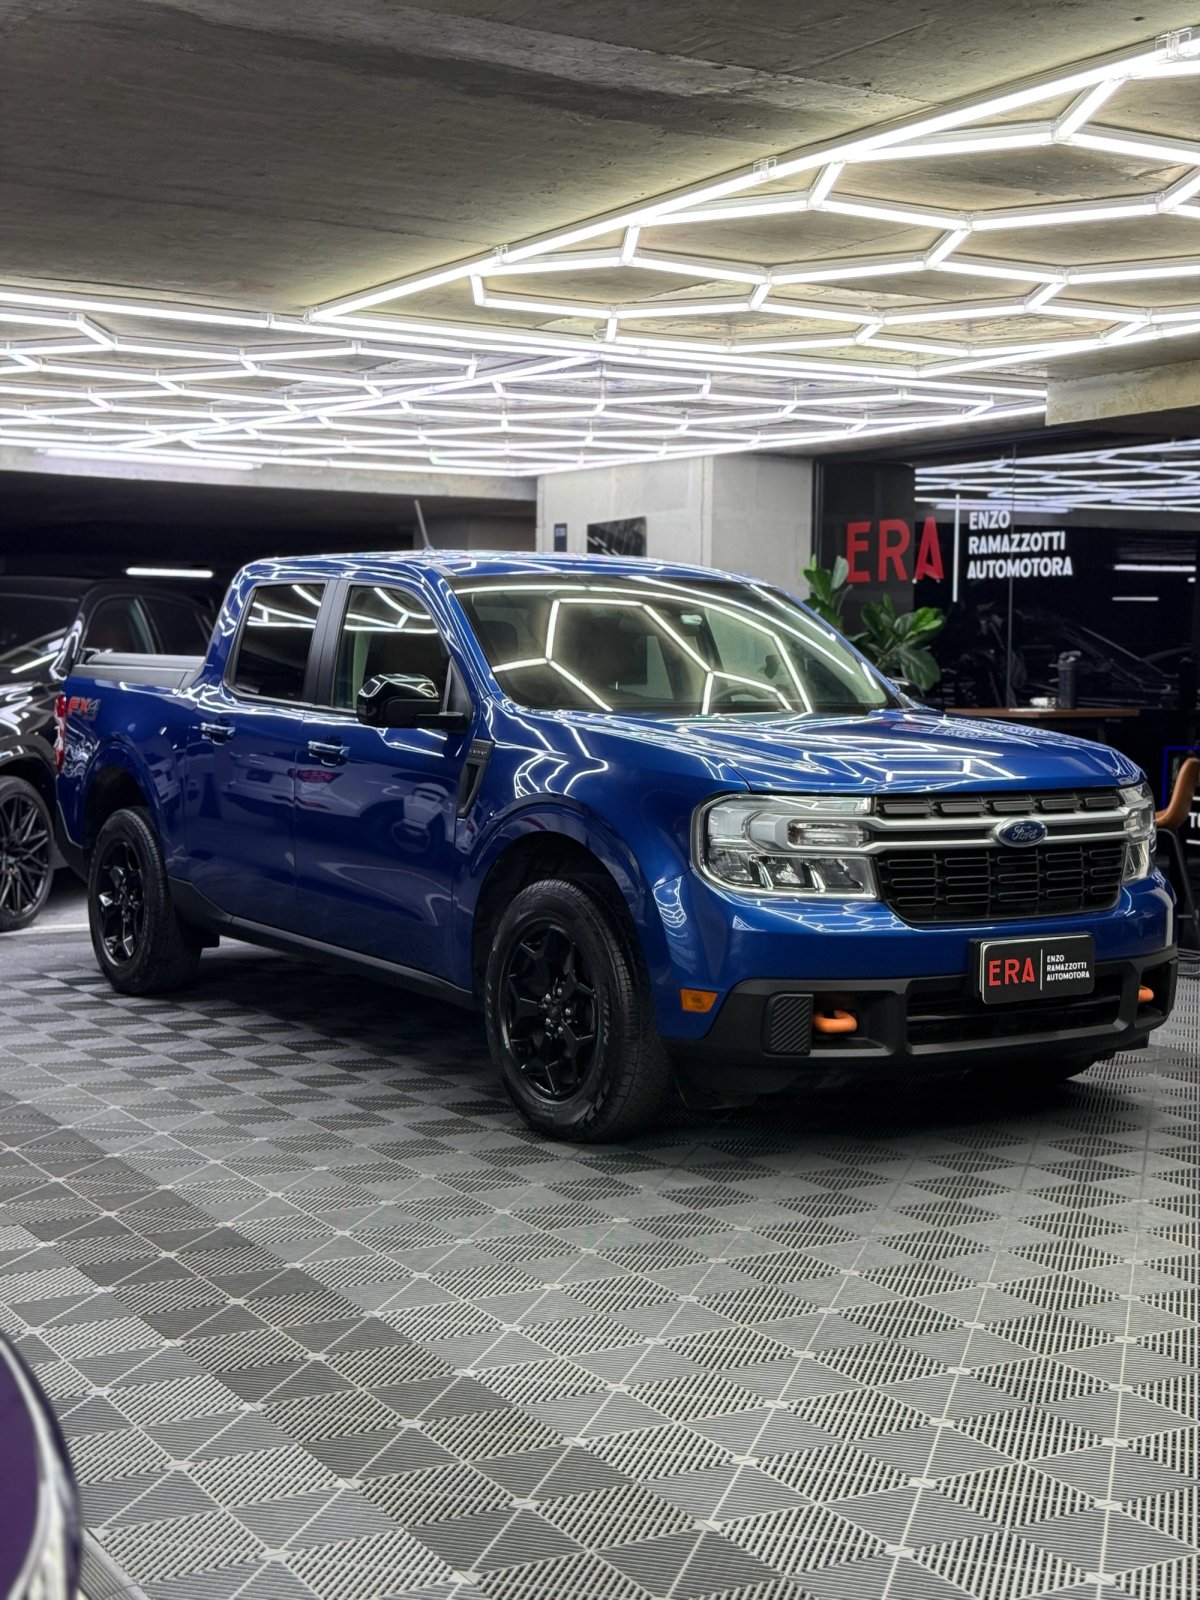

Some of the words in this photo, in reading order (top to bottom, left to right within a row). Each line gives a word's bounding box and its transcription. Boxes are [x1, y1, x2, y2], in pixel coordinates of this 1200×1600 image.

[968, 510, 1011, 530] ENZO
[846, 516, 944, 583] ERA
[968, 531, 1066, 555] RAMAZZOTTI
[967, 556, 1073, 579] AUTOMOTORA
[67, 696, 101, 717] FX4
[1011, 825, 1038, 840] Ford
[1046, 954, 1065, 963] ENZO
[1046, 962, 1087, 972] RAMAZZOTTI
[988, 957, 1035, 986] ERA
[1046, 970, 1090, 981] AUTOMOTORA
